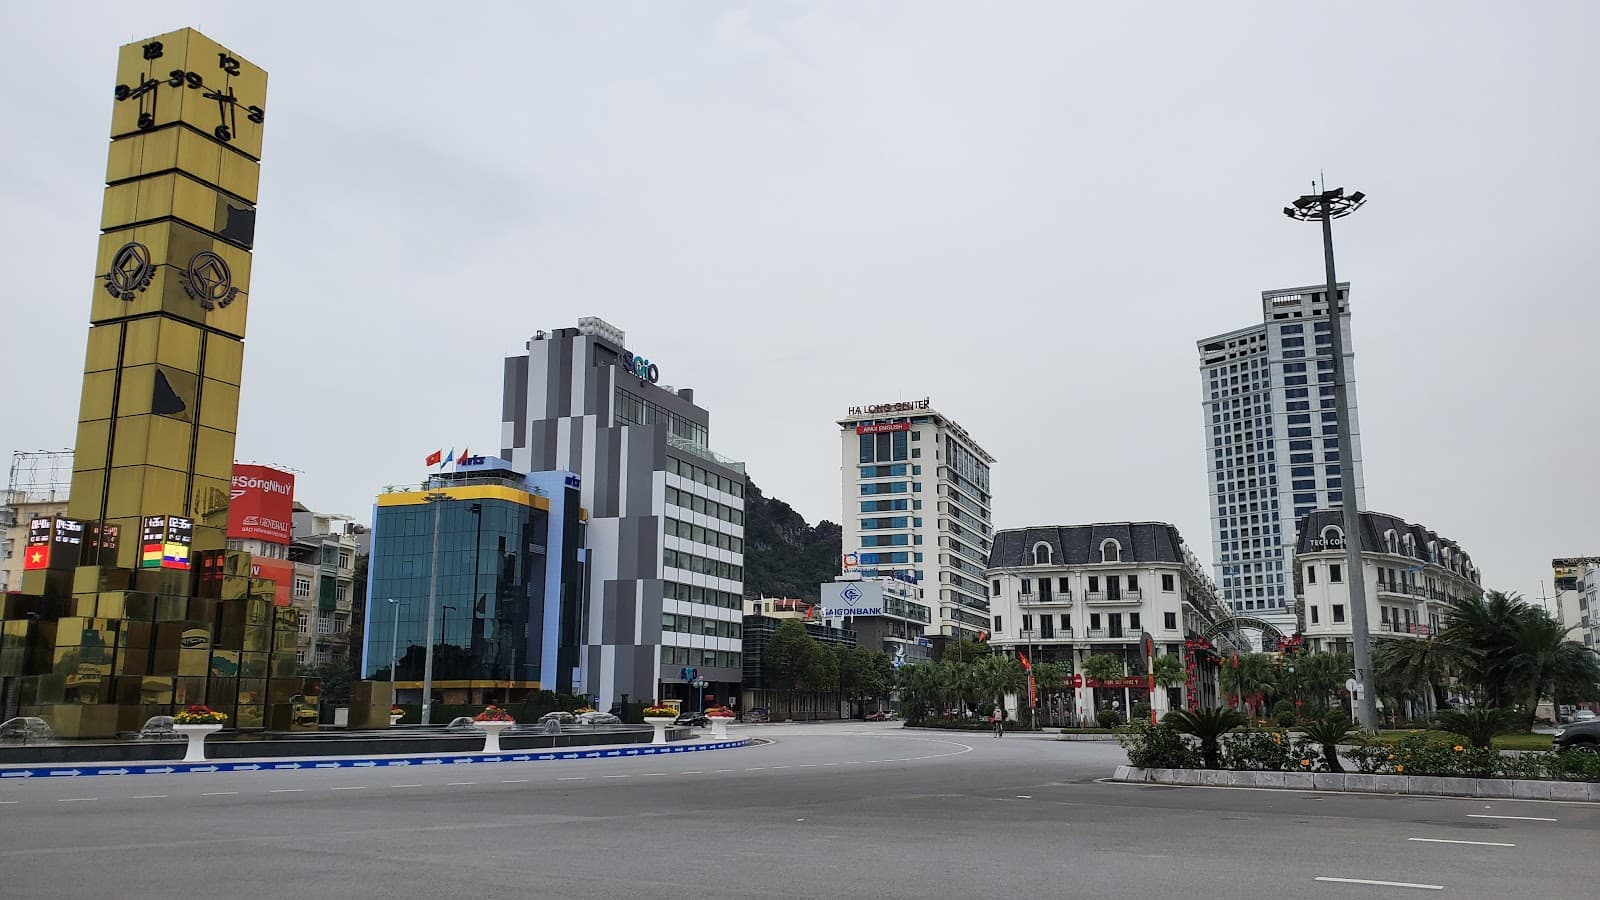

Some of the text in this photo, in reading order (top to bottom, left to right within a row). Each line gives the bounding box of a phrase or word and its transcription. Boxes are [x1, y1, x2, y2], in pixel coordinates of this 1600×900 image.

[218, 53, 240, 76] 12
[168, 69, 185, 88] 3
[186, 71, 203, 90] 9
[248, 105, 264, 124] 3
[215, 125, 231, 142] 6
[848, 406, 862, 415] HA
[864, 404, 890, 414] LONG
